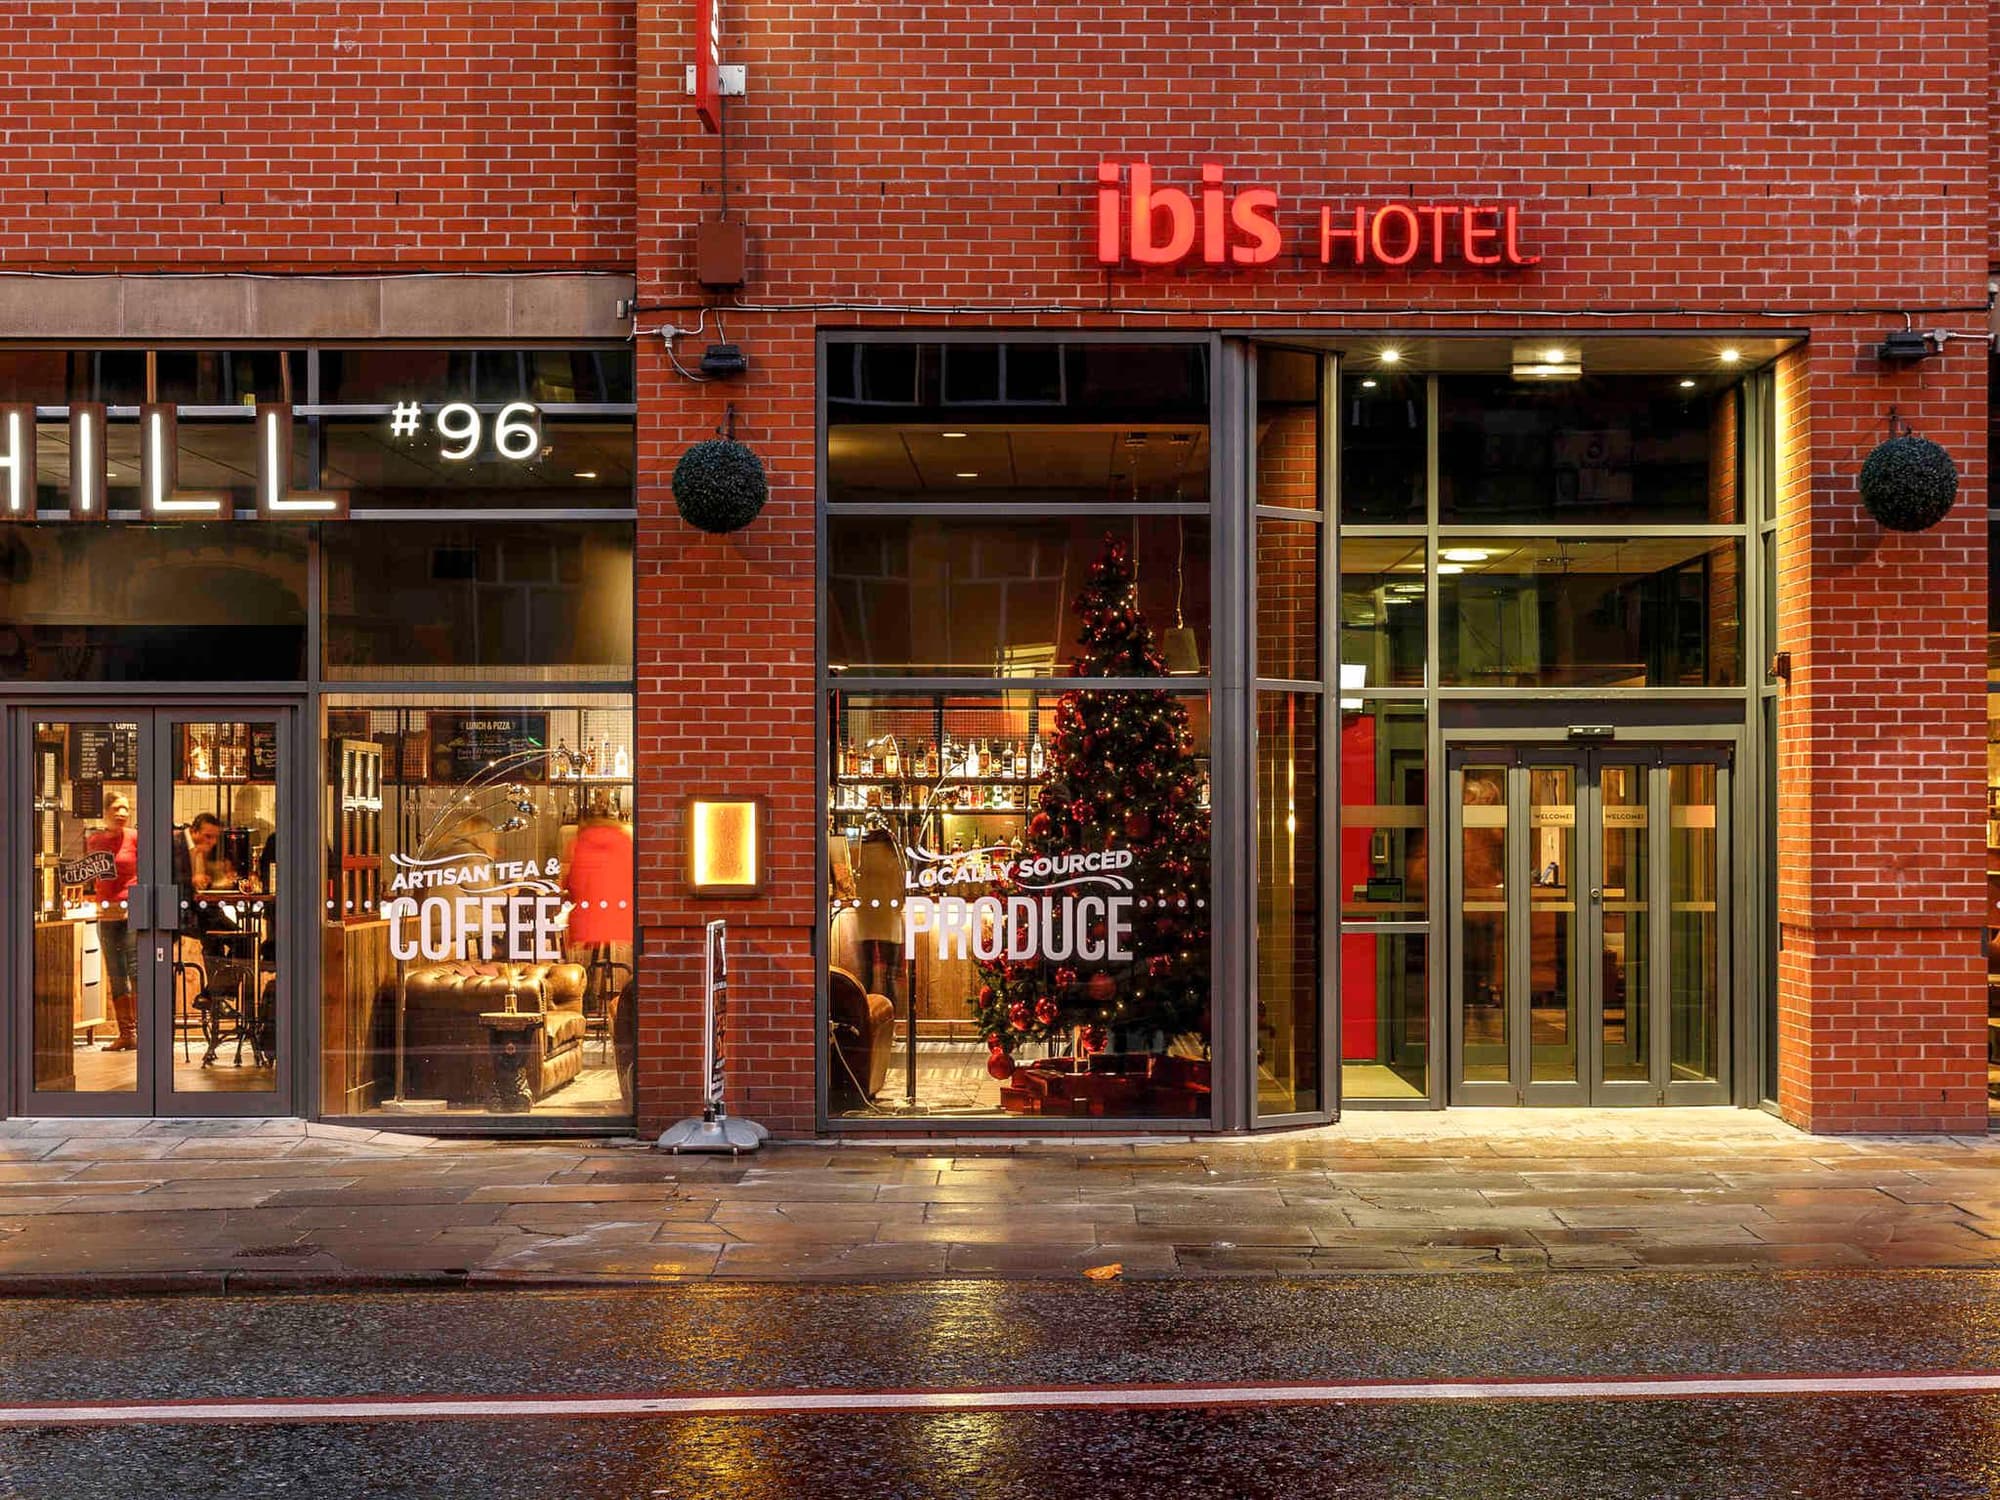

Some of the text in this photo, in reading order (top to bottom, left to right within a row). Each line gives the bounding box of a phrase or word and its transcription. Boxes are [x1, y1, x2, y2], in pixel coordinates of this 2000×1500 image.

[1098, 163, 1541, 266] ibis HOTEL
[389, 401, 538, 460] #96
[465, 720, 511, 730] LUNCH & PIZZA
[65, 858, 110, 883] CLOSED
[391, 857, 561, 891] ARTISAN TEA &
[904, 850, 1134, 889] LOCALLY SOURCED
[389, 896, 561, 961] COFFEE
[904, 896, 1134, 961] PRODUCE
